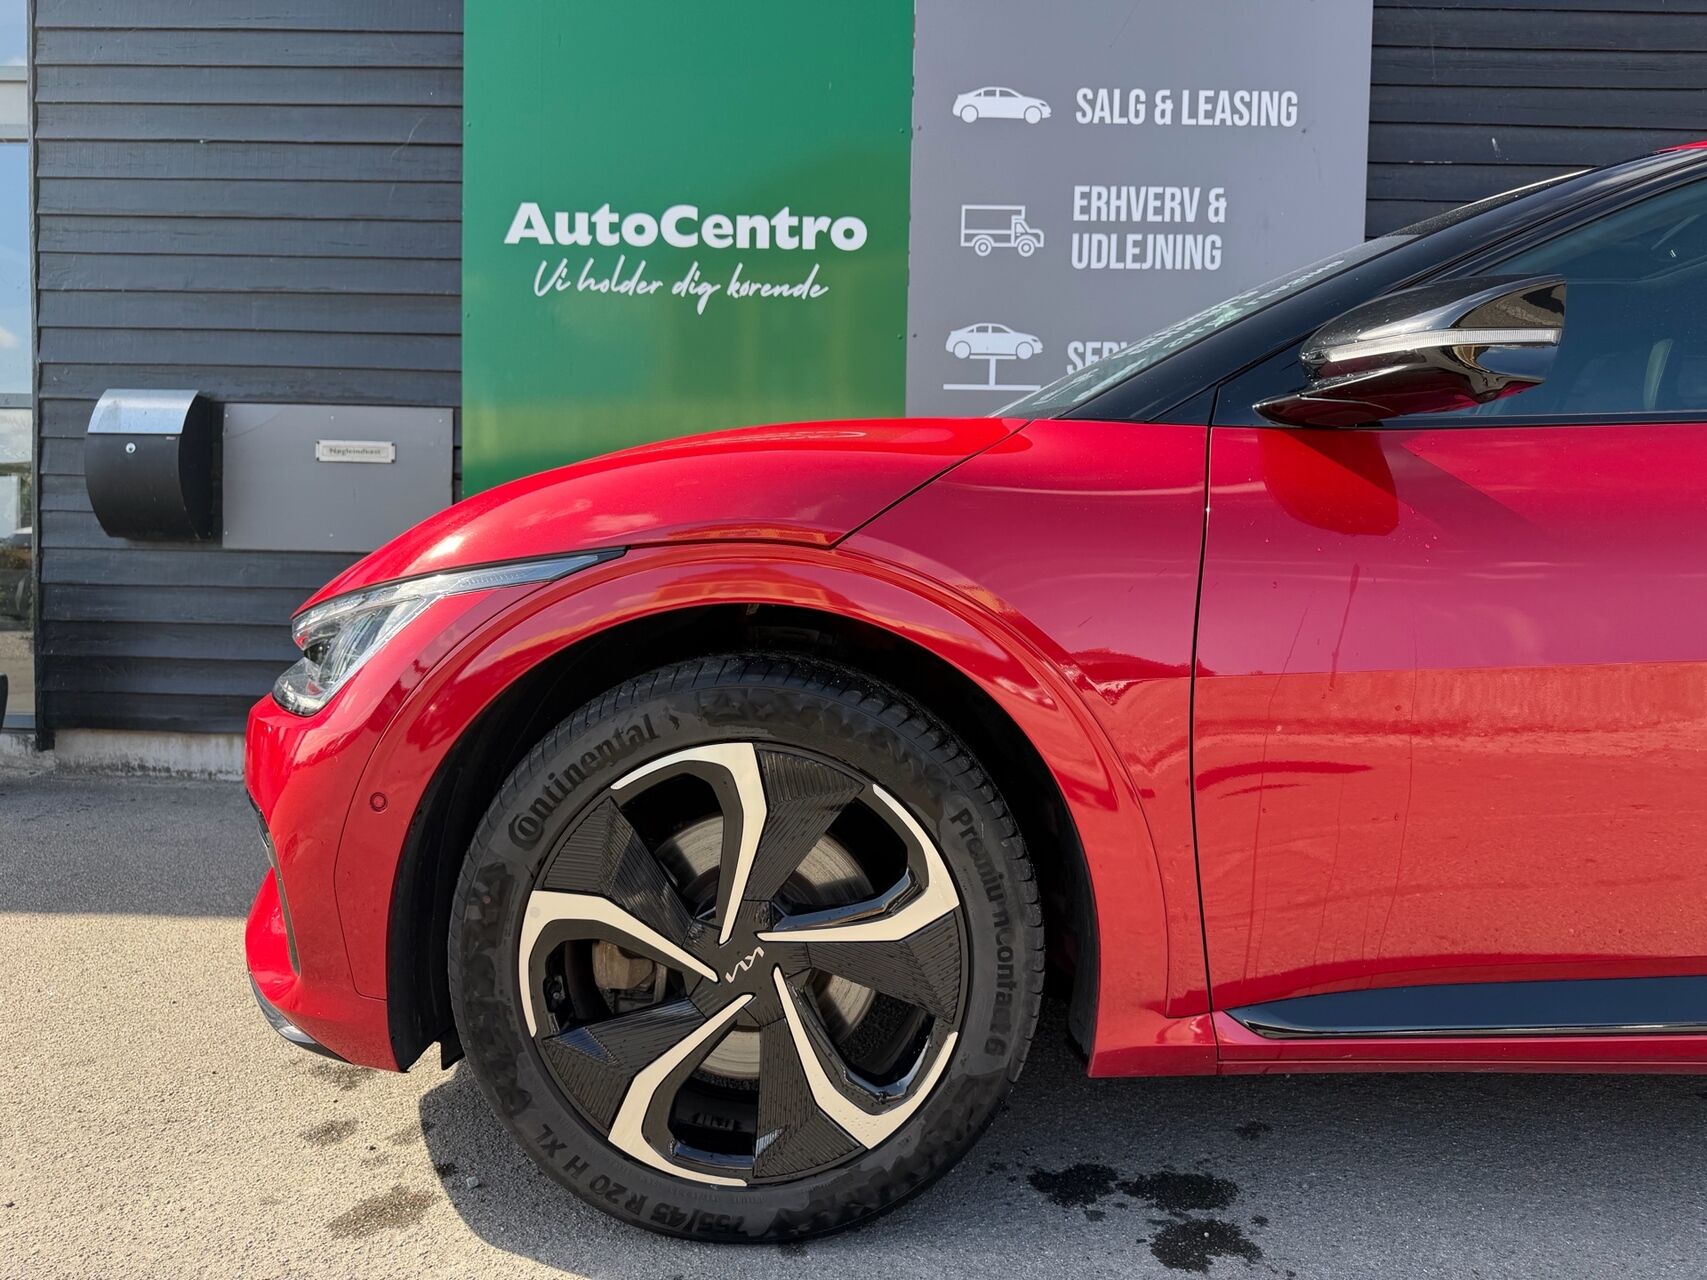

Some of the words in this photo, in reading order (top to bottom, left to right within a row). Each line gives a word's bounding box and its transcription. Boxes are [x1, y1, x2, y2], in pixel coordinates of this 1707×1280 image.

[1075, 88, 1146, 124] SALG
[1154, 89, 1173, 125] &
[1181, 90, 1298, 127] LEASING
[1073, 185, 1200, 223] ERHVERV
[1208, 187, 1227, 223] &
[504, 202, 868, 251] AutoCentro
[1071, 233, 1222, 270] UDLEJNING
[533, 257, 571, 297] Vi
[577, 254, 663, 295] holder
[672, 261, 721, 315] dig
[727, 262, 829, 300] kørende
[508, 713, 660, 851] Continental
[535, 1123, 568, 1158] XL
[562, 1154, 591, 1180] H
[589, 1174, 628, 1204] 20
[624, 1193, 649, 1216] R
